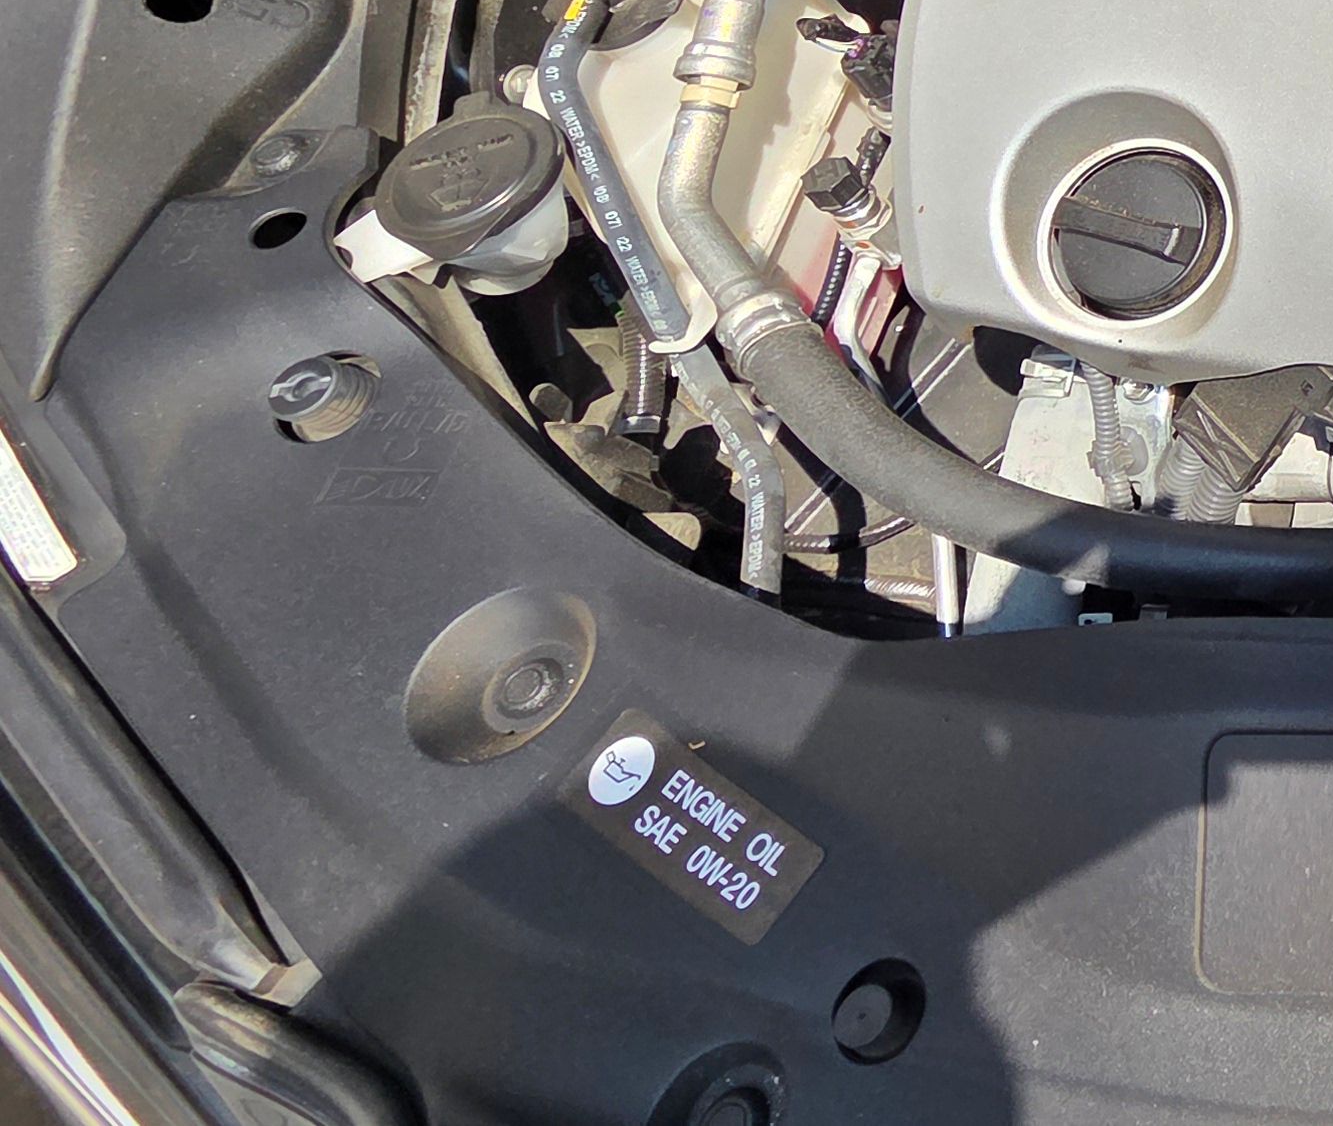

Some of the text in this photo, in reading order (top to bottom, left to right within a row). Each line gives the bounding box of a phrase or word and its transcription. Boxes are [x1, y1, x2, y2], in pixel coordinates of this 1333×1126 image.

[634, 804, 761, 911] SAE 0W-20
[660, 768, 788, 878] ENGINE OIL
